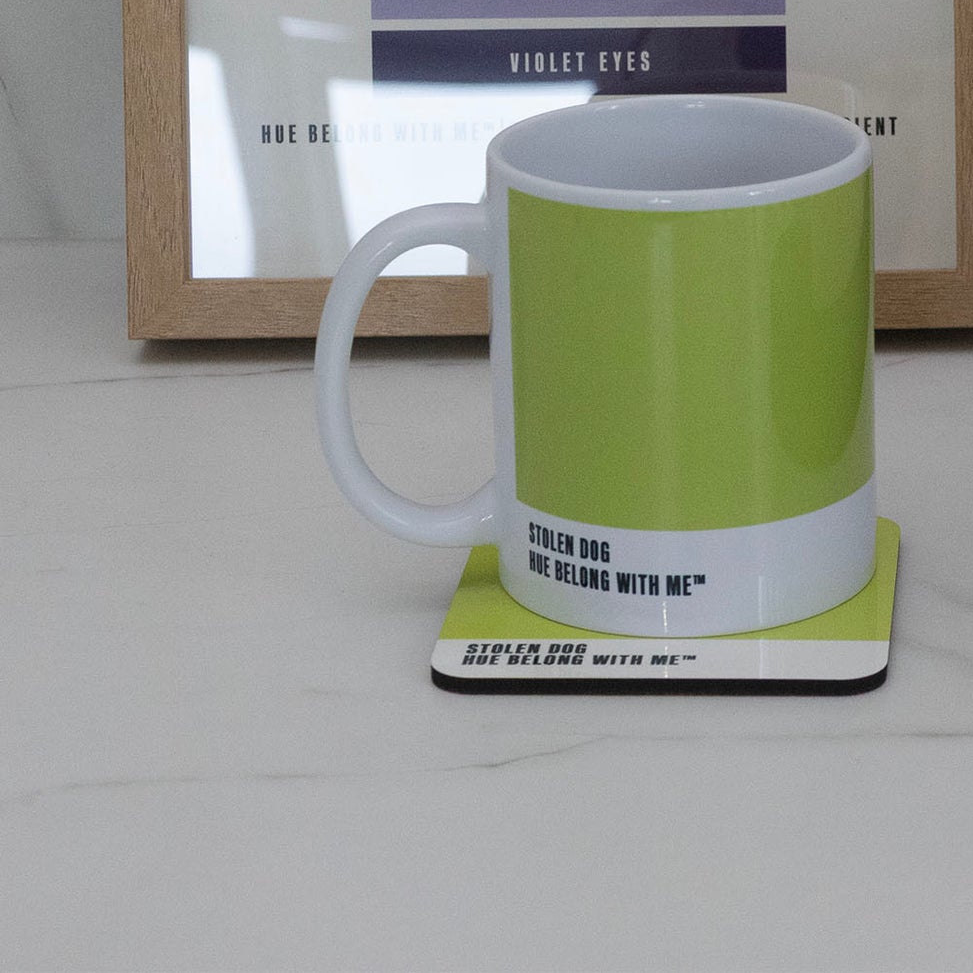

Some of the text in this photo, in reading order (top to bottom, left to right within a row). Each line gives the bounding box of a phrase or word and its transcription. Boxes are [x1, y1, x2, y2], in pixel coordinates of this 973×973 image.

[510, 51, 650, 73] VIOLET EYES
[261, 124, 297, 144] HUE
[529, 521, 610, 563] STOLEN DOG
[529, 550, 550, 577] HUE
[555, 559, 610, 592] BELONG
[616, 572, 659, 595] WITH
[465, 643, 588, 654] STOLEN DOG
[461, 654, 500, 666] HUE
[506, 654, 584, 666] BELONG
[592, 654, 643, 666] WITH
